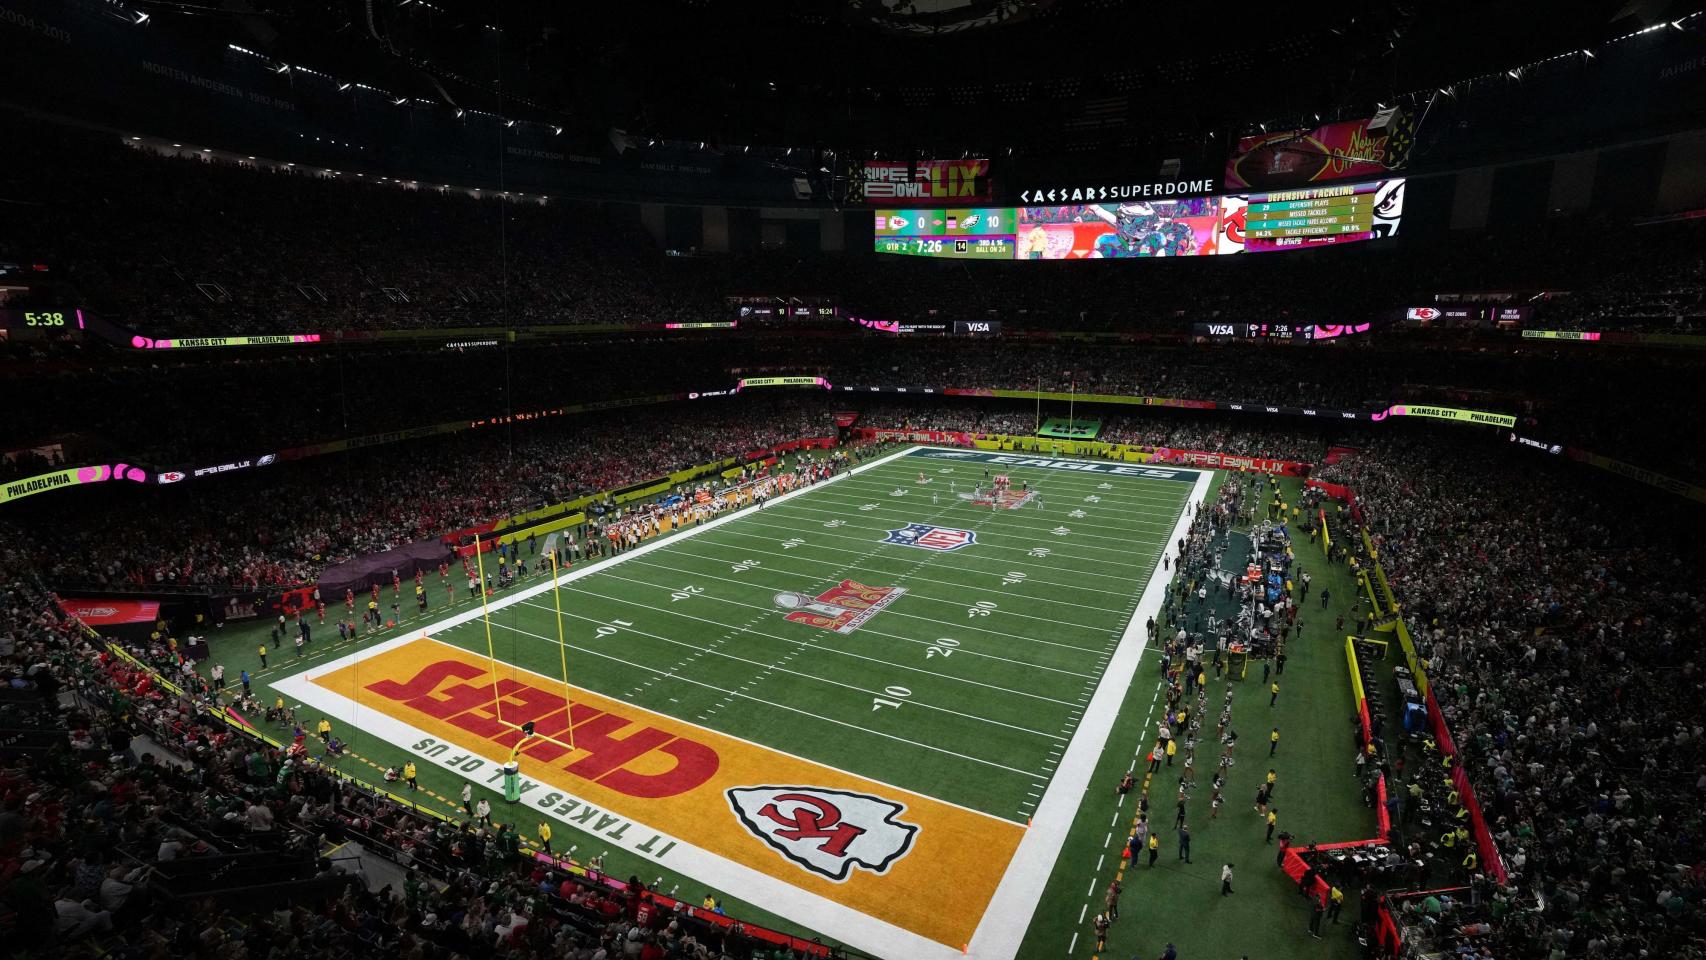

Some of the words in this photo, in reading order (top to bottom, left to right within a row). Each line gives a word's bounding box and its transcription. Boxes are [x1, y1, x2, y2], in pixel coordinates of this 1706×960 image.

[142, 60, 188, 82] MORTEN
[190, 76, 242, 97] ANDERSEN
[864, 167, 931, 182] SUPER
[932, 166, 981, 197] LIX
[864, 182, 931, 197] BOWL
[1021, 186, 1108, 203] CAESARS
[1110, 179, 1214, 199] SUPERDOME
[1268, 190, 1310, 202] DEFENSIVE
[1312, 186, 1354, 198] TACKLING
[918, 217, 925, 228] 0
[987, 216, 1000, 228] 10
[1286, 228, 1302, 236] TACKLE
[887, 243, 899, 251] QTR
[902, 242, 907, 250] 2
[916, 240, 943, 253] 7:26
[957, 242, 966, 250] 14
[25, 312, 64, 327] 5:38
[1480, 310, 1484, 318] 1
[966, 322, 990, 332] VISA
[1208, 325, 1234, 335] VISA
[179, 338, 210, 348] KANSAS
[211, 338, 227, 346] CITY
[247, 336, 291, 344] PHILADELPHIA
[1411, 408, 1440, 417] KANSAS
[1442, 410, 1458, 418] CITY
[1471, 414, 1514, 426] PHILADELPHIA
[194, 467, 218, 477] SUPER
[238, 460, 250, 468] LIX
[988, 456, 1176, 478] EAGLES
[1183, 452, 1221, 466] SUPER
[1222, 457, 1259, 470] BOWL
[1262, 461, 1284, 473] LIX
[7, 473, 71, 498] PHILADELPHIA
[918, 530, 967, 548] NFL
[1004, 572, 1027, 584] 40
[672, 586, 705, 600] 20
[846, 608, 876, 628] SUPER
[874, 592, 900, 611] BOWL
[968, 601, 998, 616] 30
[597, 619, 634, 636] 10
[926, 638, 960, 657] 20
[874, 686, 912, 710] 10
[363, 660, 720, 799] CHIEFS
[412, 737, 449, 758] US
[444, 755, 486, 773] OF
[537, 791, 633, 841] TAKES
[757, 793, 868, 858] KC
[634, 834, 678, 859] IT
[636, 910, 648, 923] 58
